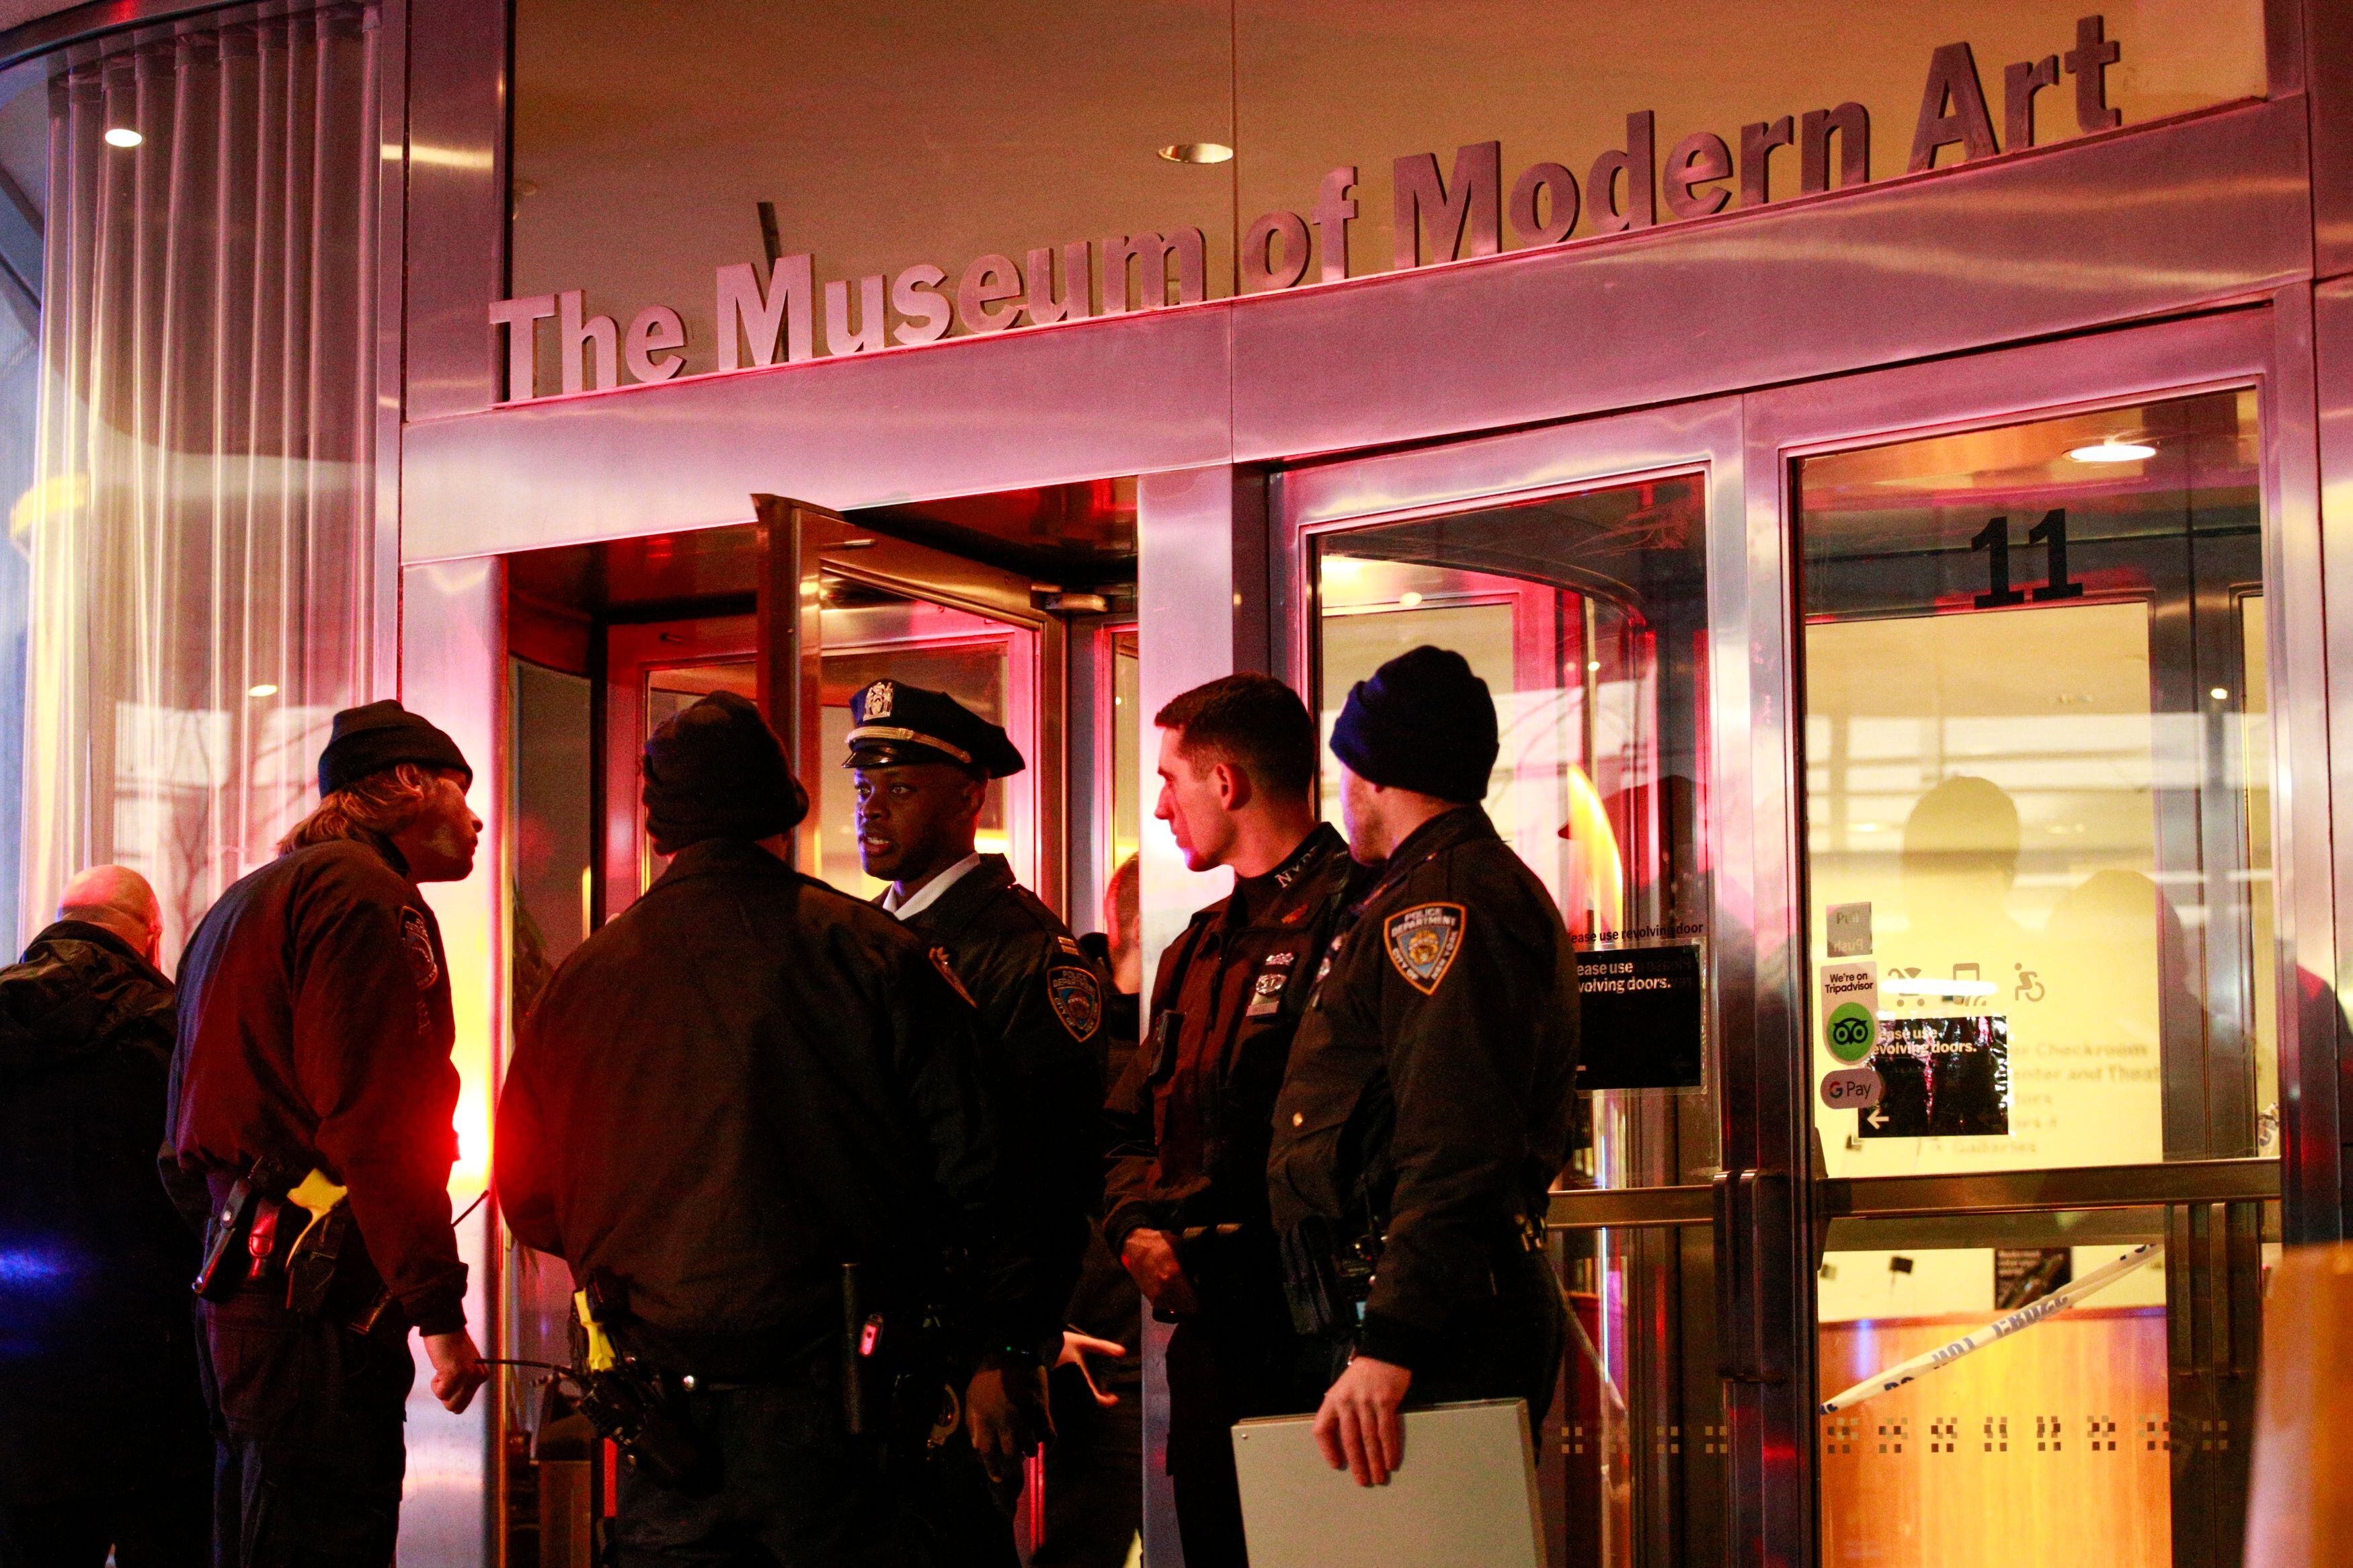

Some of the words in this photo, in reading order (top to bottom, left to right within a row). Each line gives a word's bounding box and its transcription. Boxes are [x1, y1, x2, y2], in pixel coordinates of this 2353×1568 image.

[489, 287, 688, 403] The
[716, 224, 1207, 372] Museum
[1241, 165, 1359, 289] of
[1392, 101, 1871, 270] Modern
[1907, 15, 2122, 173] Art
[1970, 508, 2083, 610] 11
[1391, 915, 1457, 938] DEPARTMENT
[1569, 931, 1597, 944] ease
[1599, 930, 1619, 941] use
[1622, 924, 1676, 940] revolving
[1676, 922, 1704, 934] door
[1577, 962, 1607, 976] ease
[1609, 962, 1634, 974] use
[1829, 973, 1855, 984] We're
[1856, 972, 1868, 982] on
[1578, 977, 1626, 994] volving
[1627, 975, 1672, 991] doors.
[1825, 981, 1874, 995] Tripadvisor
[1873, 1042, 1929, 1055] evolving
[1930, 1041, 1978, 1054] doors.
[1846, 1081, 1872, 1100] Pay
